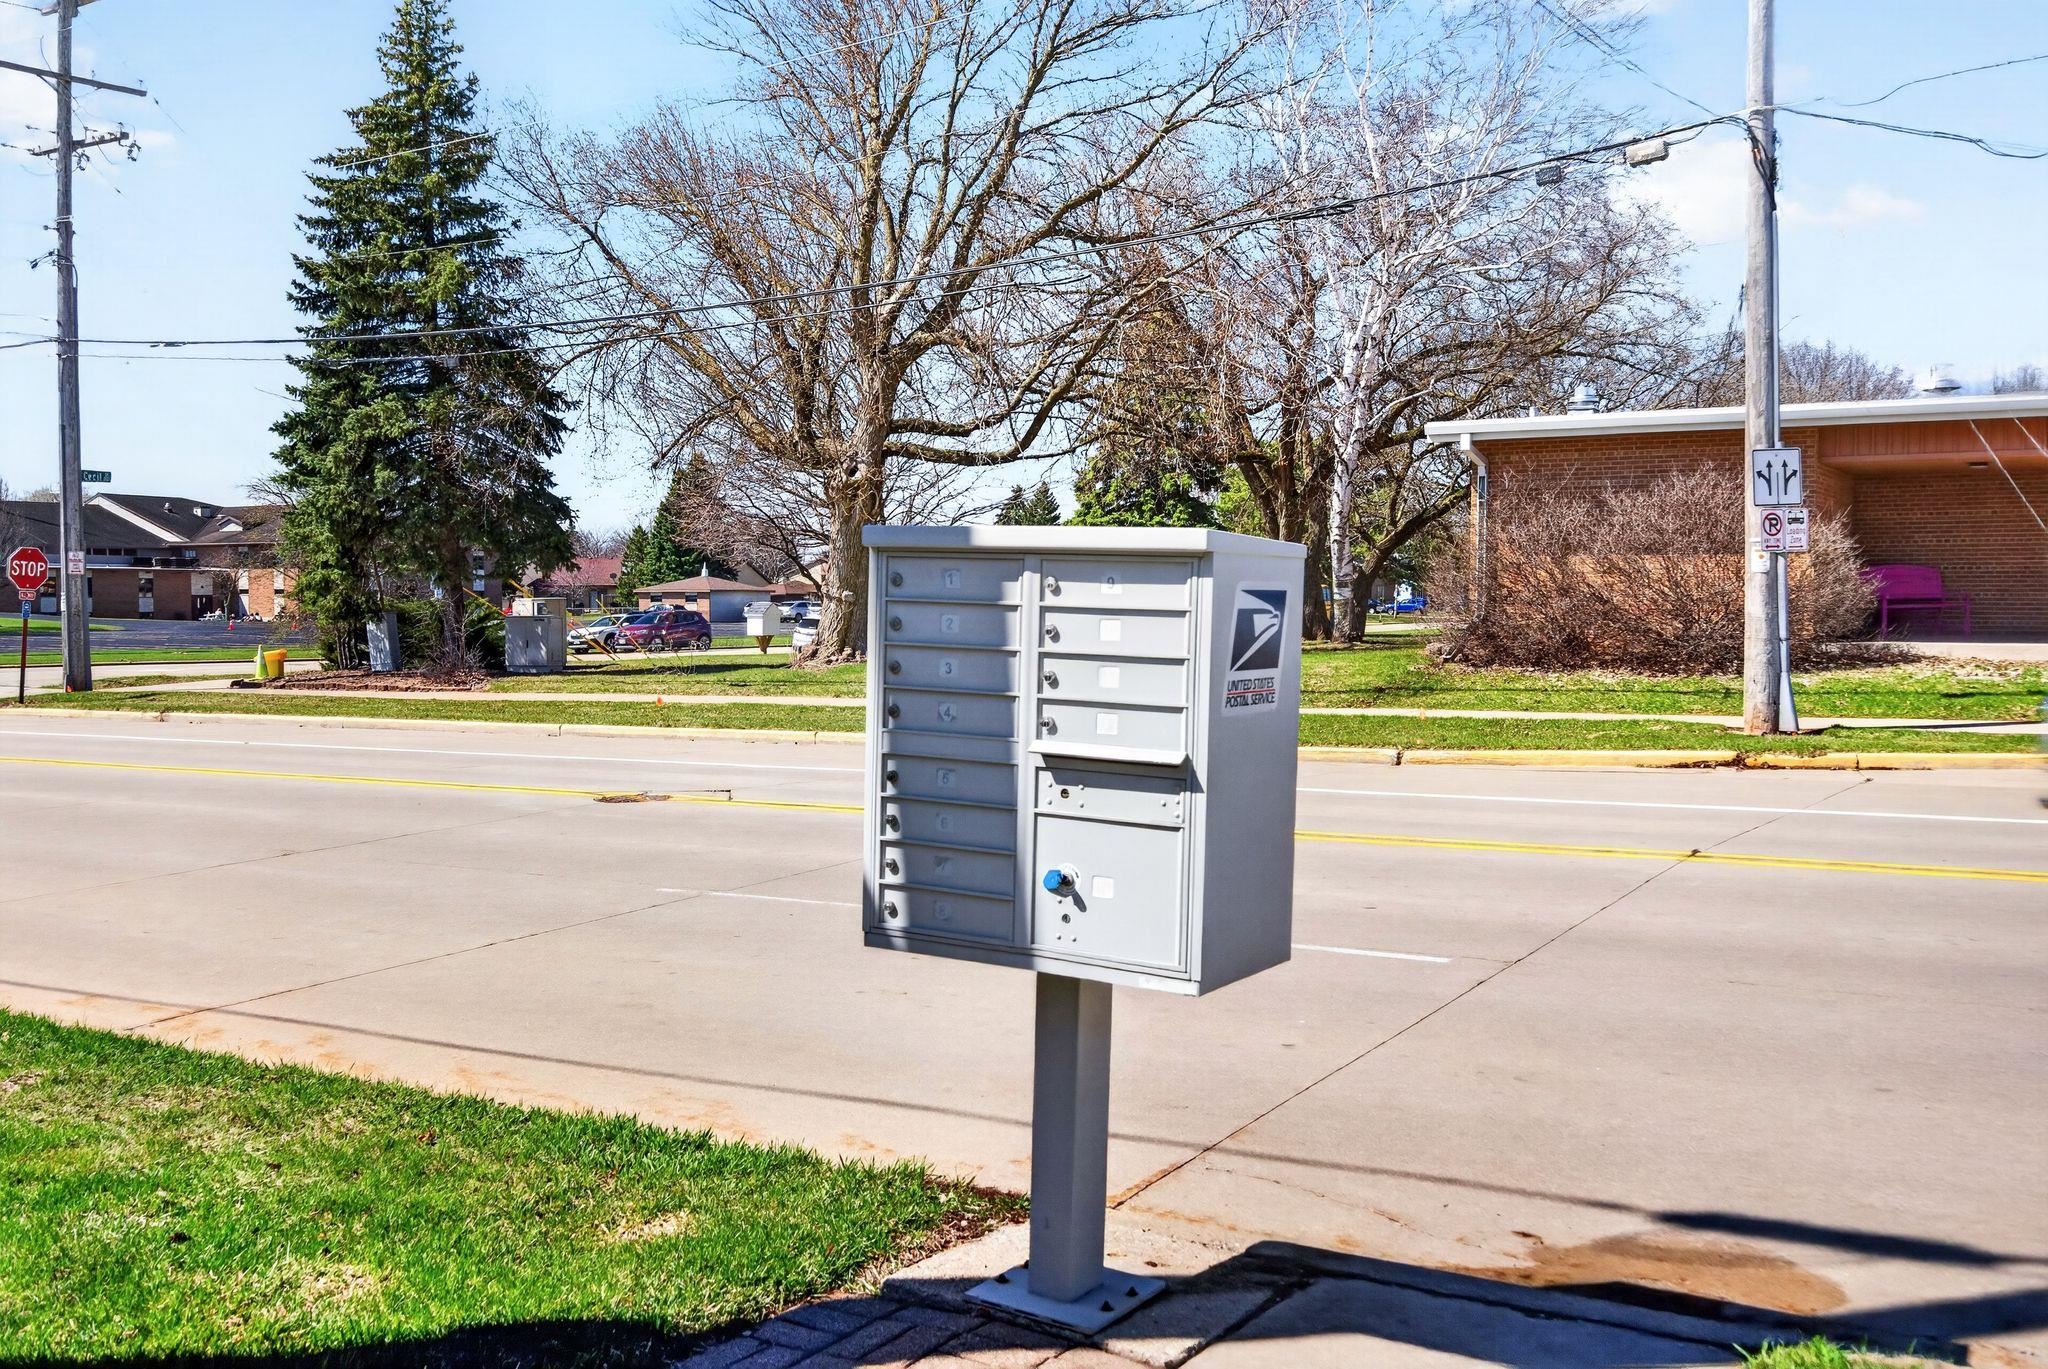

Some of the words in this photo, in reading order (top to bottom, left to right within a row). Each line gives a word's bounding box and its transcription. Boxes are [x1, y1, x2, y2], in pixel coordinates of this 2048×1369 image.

[83, 471, 103, 481] Cecil
[11, 560, 46, 577] STOP
[947, 573, 953, 585] 1
[945, 617, 954, 630] 2
[944, 662, 953, 675] 3
[1228, 679, 1252, 692] UNITED
[1252, 677, 1275, 690] STATES
[1225, 695, 1249, 708] POSTAL
[1251, 692, 1276, 705] SERVICE
[943, 706, 951, 719] 4
